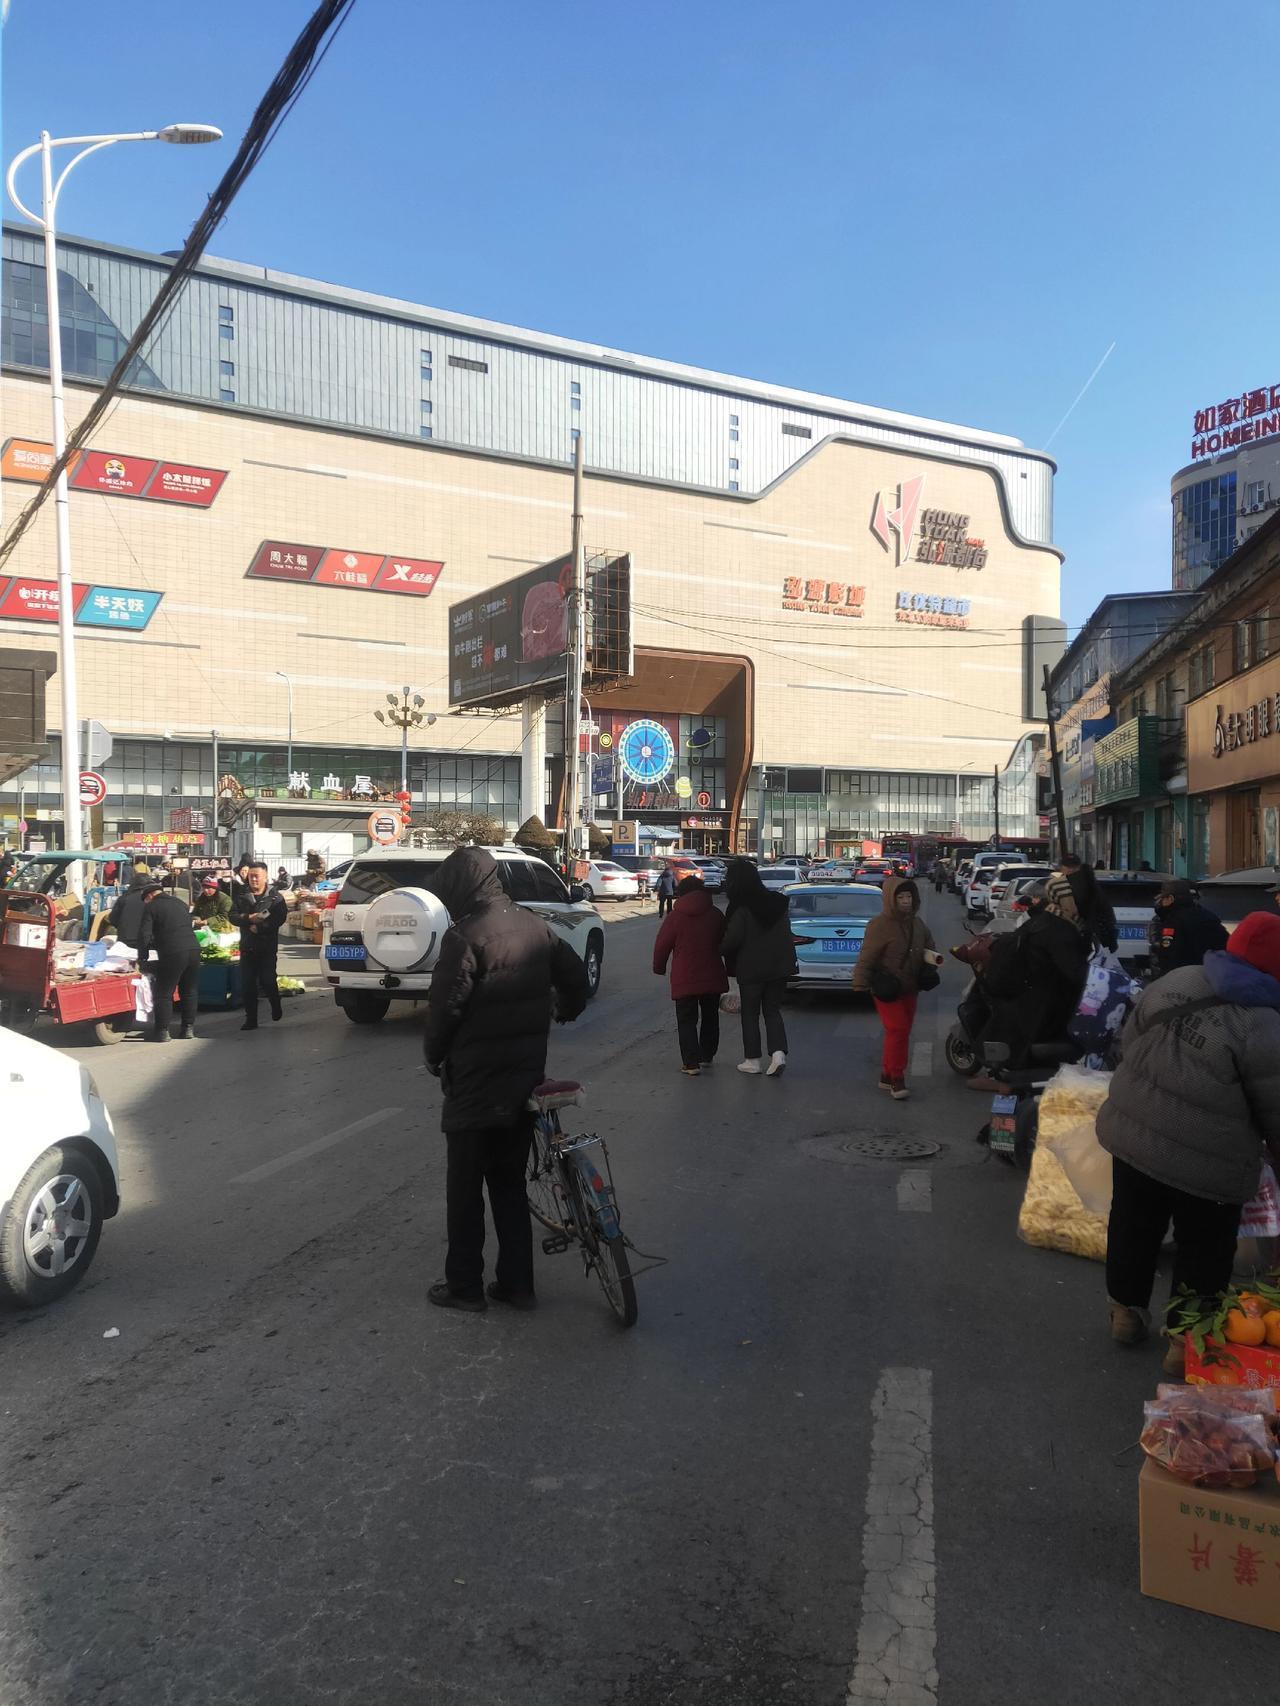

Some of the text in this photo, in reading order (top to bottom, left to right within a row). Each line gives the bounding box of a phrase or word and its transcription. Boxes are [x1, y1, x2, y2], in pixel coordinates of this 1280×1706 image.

[1191, 412, 1280, 459] HOMEIN
[287, 770, 375, 796] 献血屋
[376, 919, 417, 927] PRADO
